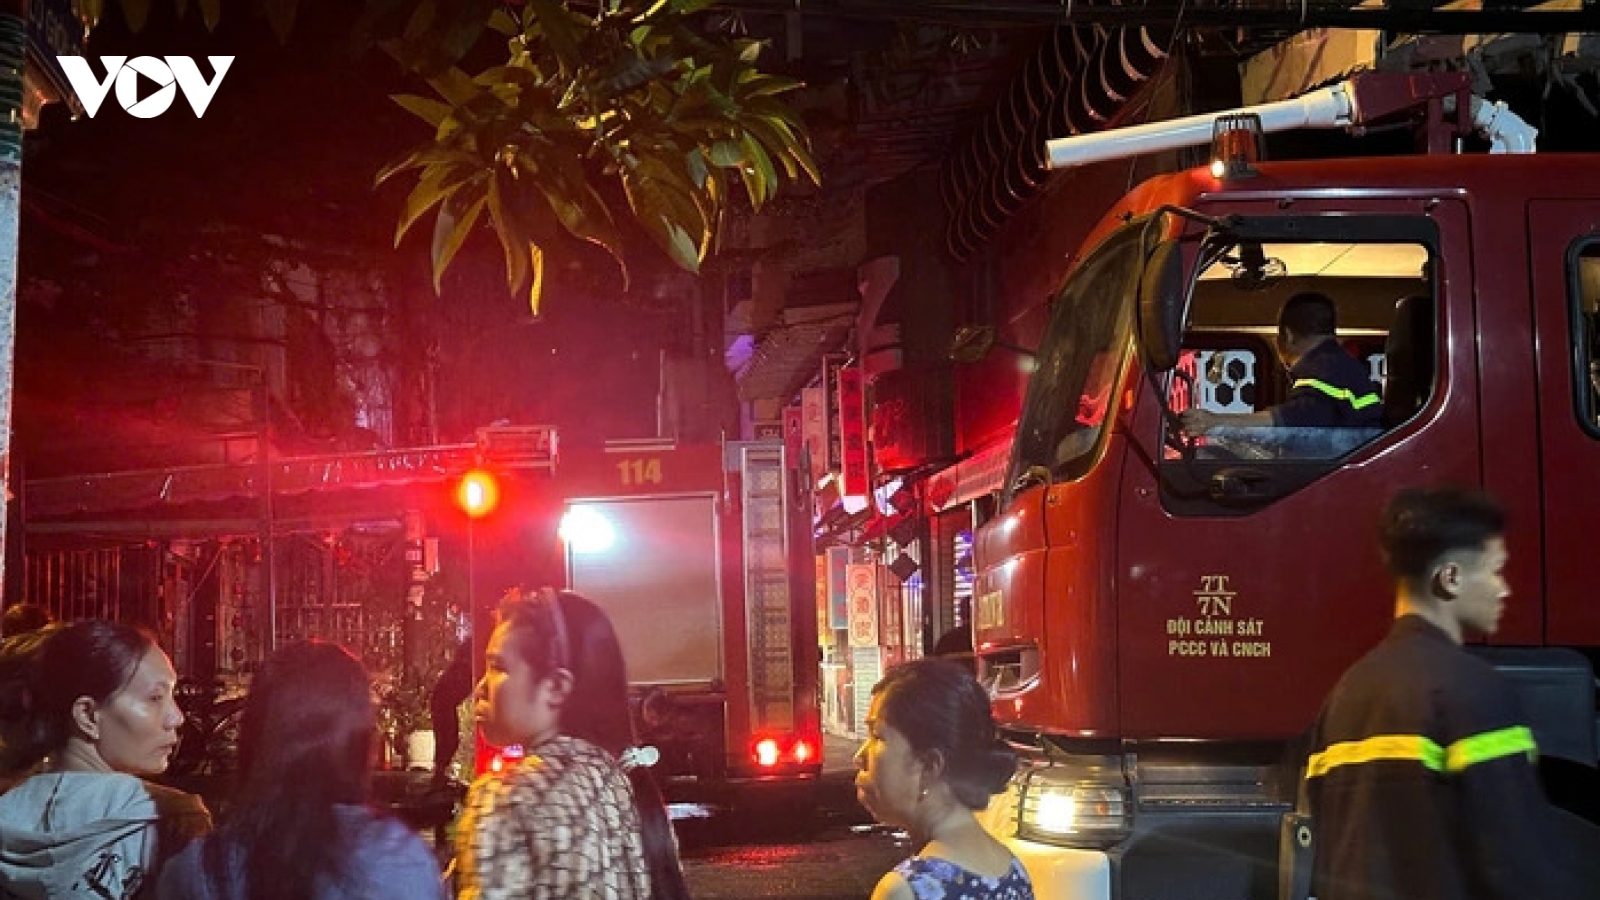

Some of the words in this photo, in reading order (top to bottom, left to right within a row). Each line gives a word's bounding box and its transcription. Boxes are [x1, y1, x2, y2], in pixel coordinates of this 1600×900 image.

[616, 458, 662, 485] 114
[1201, 575, 1230, 592] 7T
[1197, 596, 1232, 616] 7N
[1167, 615, 1191, 638] ĐỘI
[1194, 615, 1234, 635] CẢNH
[1237, 617, 1264, 636] SÁT
[1168, 639, 1207, 657] PCCC
[1232, 642, 1271, 658] CNCH
